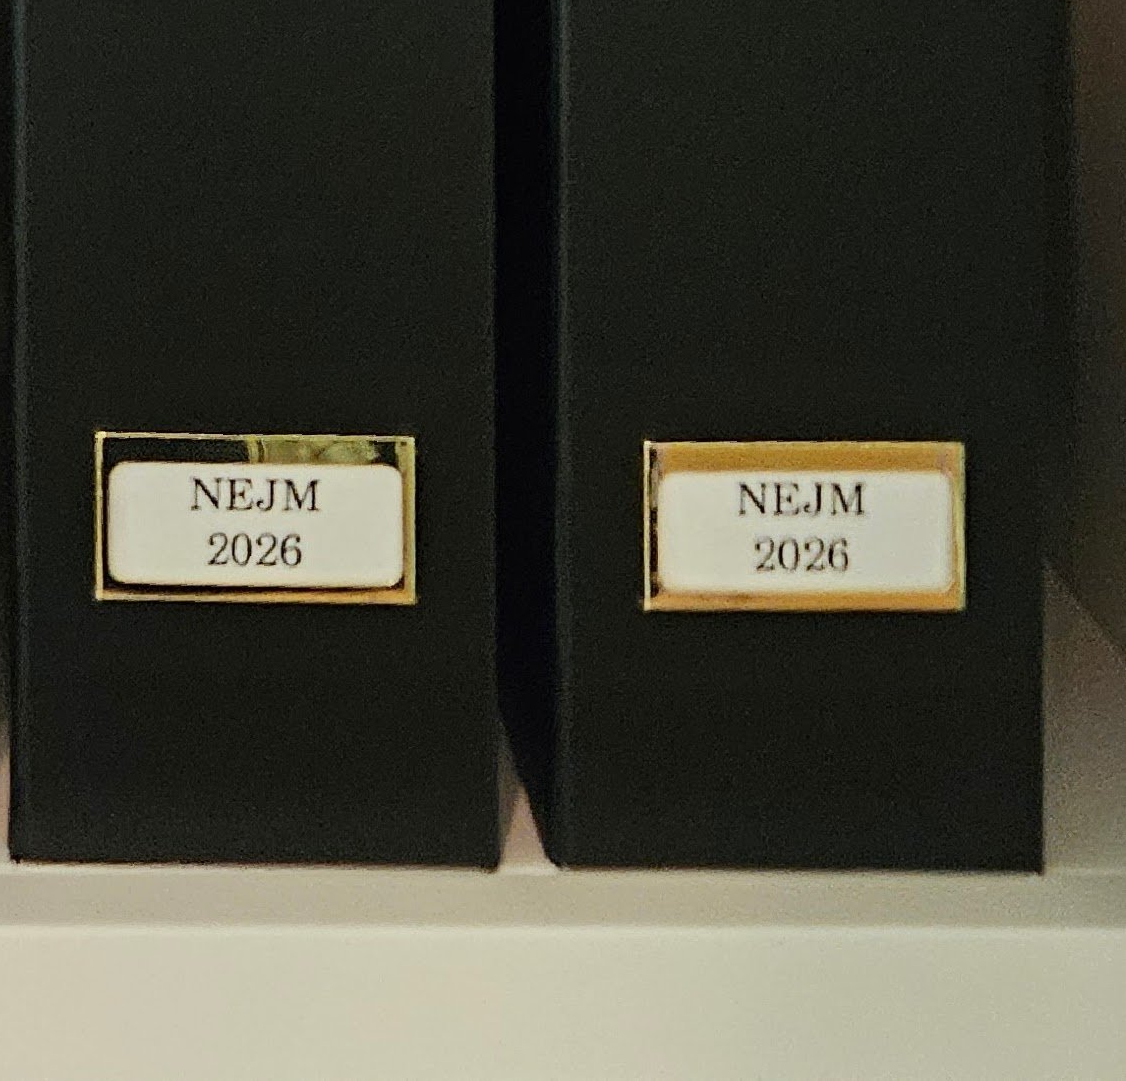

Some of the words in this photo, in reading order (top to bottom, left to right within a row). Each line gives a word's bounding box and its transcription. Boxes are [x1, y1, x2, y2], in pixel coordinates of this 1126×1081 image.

[189, 477, 321, 512] NEJM
[738, 482, 867, 518] NEJM
[207, 532, 303, 567] 2026
[754, 537, 851, 572] 2026
